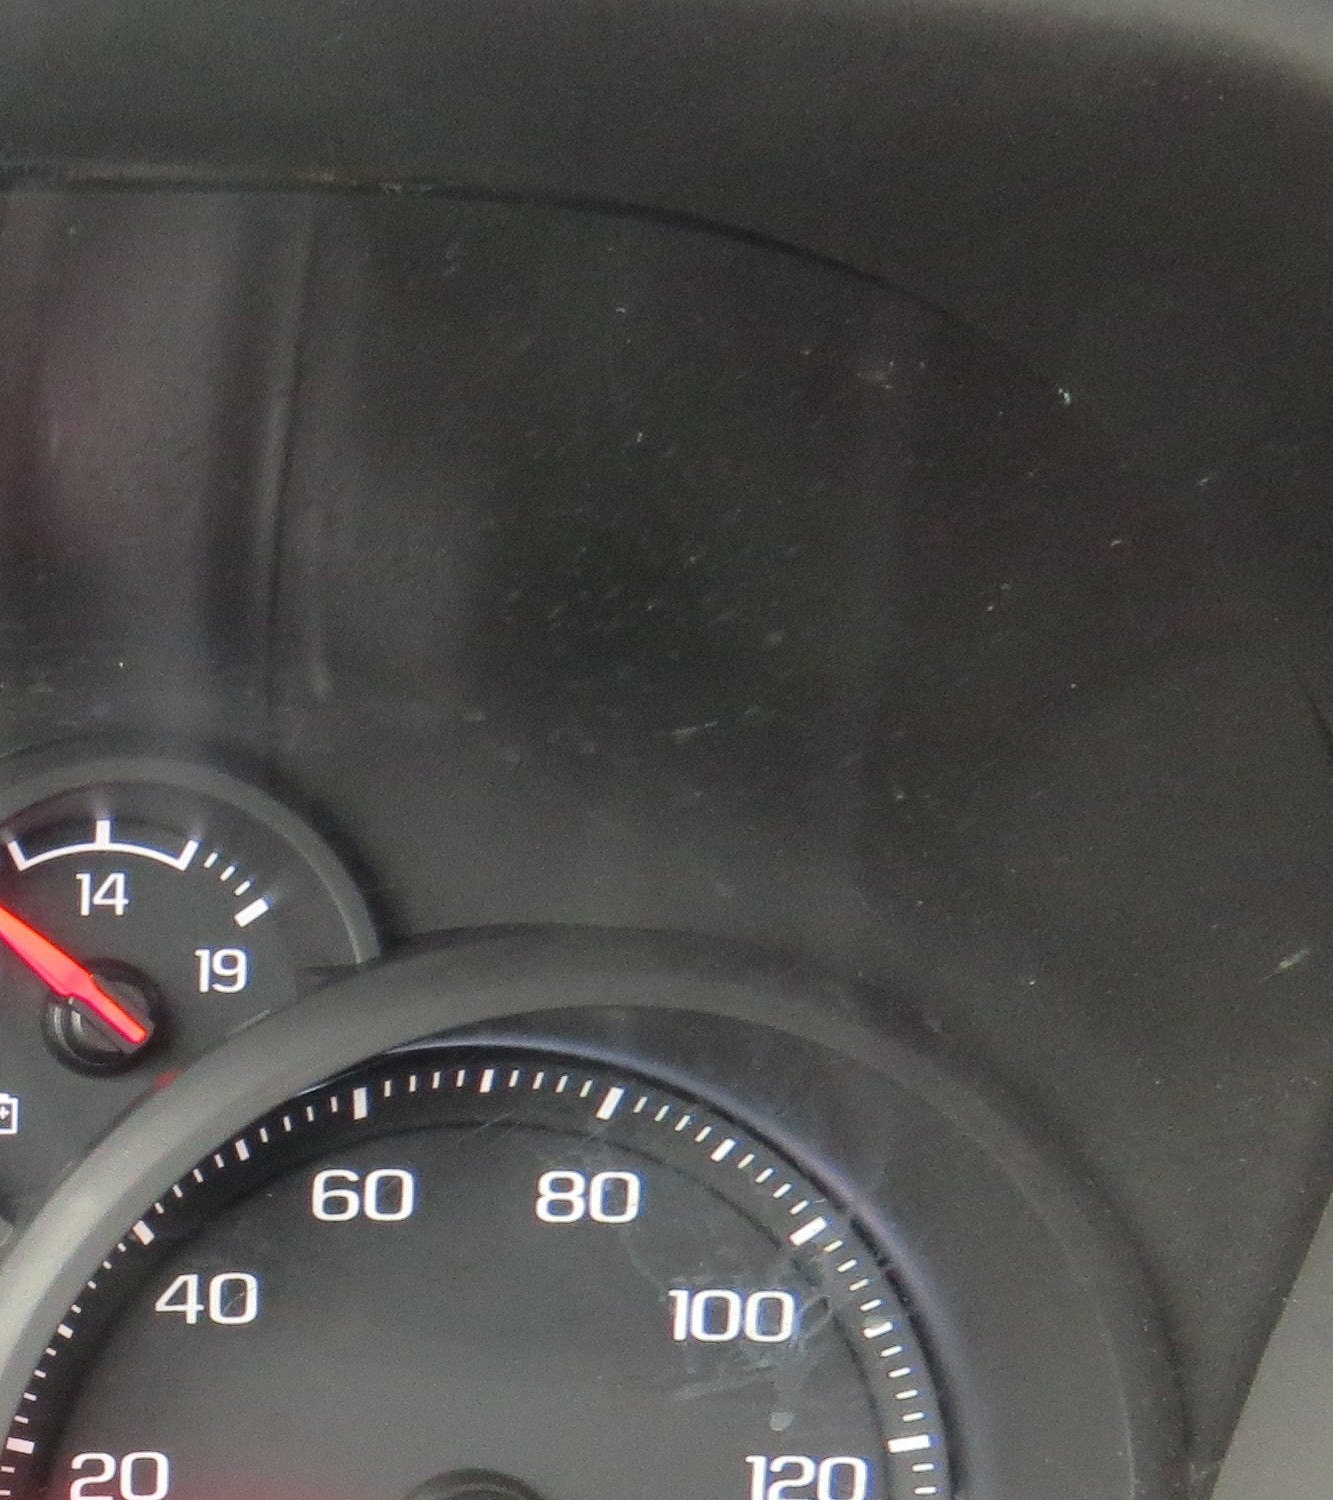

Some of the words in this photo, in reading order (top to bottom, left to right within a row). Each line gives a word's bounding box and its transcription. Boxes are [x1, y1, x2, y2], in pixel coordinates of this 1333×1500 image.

[75, 872, 130, 916] 14
[194, 948, 248, 993] 19
[311, 1168, 415, 1222] 60
[535, 1170, 641, 1223] 80
[155, 1272, 258, 1325] 40
[668, 1289, 796, 1343] 100
